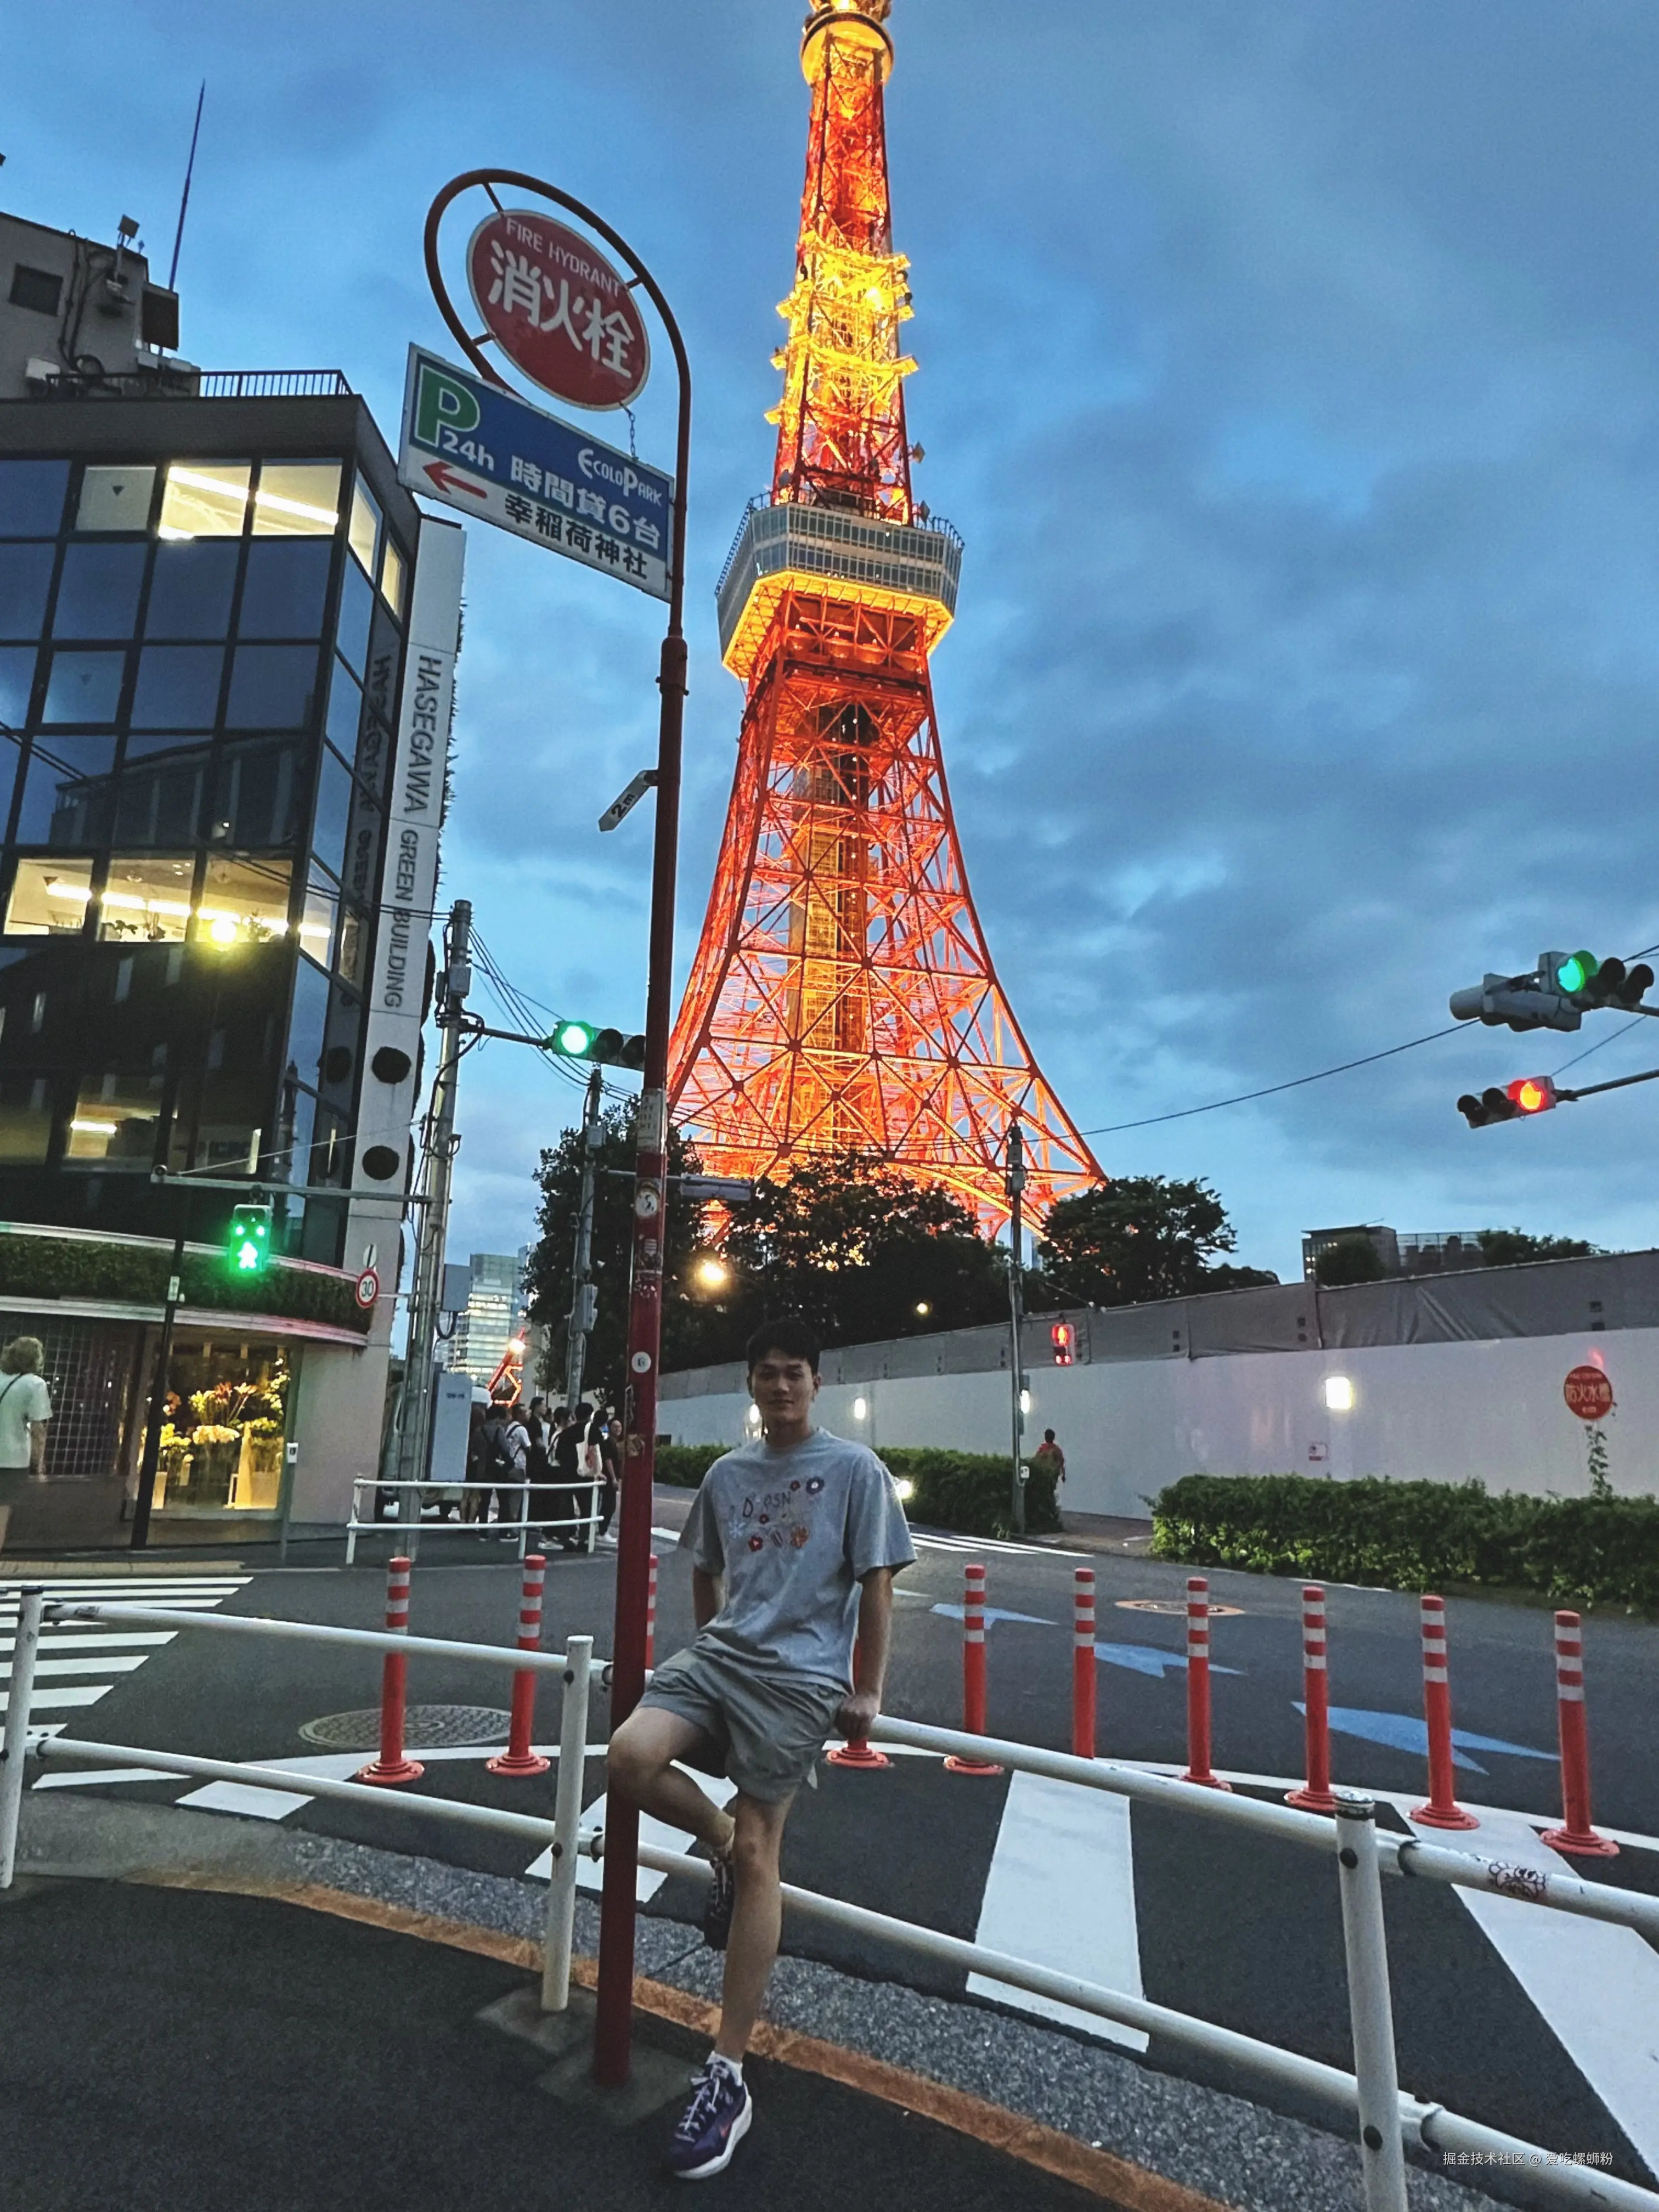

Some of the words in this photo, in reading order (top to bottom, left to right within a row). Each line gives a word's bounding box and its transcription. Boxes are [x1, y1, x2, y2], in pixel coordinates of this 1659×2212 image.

[506, 218, 543, 253] FIRE
[549, 241, 620, 297] HYDRANT
[488, 240, 635, 378] 消火栓
[415, 363, 481, 448] P
[442, 430, 494, 471] 24h
[511, 454, 661, 550] 時間貸6台
[505, 493, 647, 580] 幸稲荷神社
[404, 654, 442, 814] HASEGAWA
[395, 829, 419, 901] GREEN
[384, 908, 410, 1009] BUILDING
[362, 1280, 374, 1297] 30
